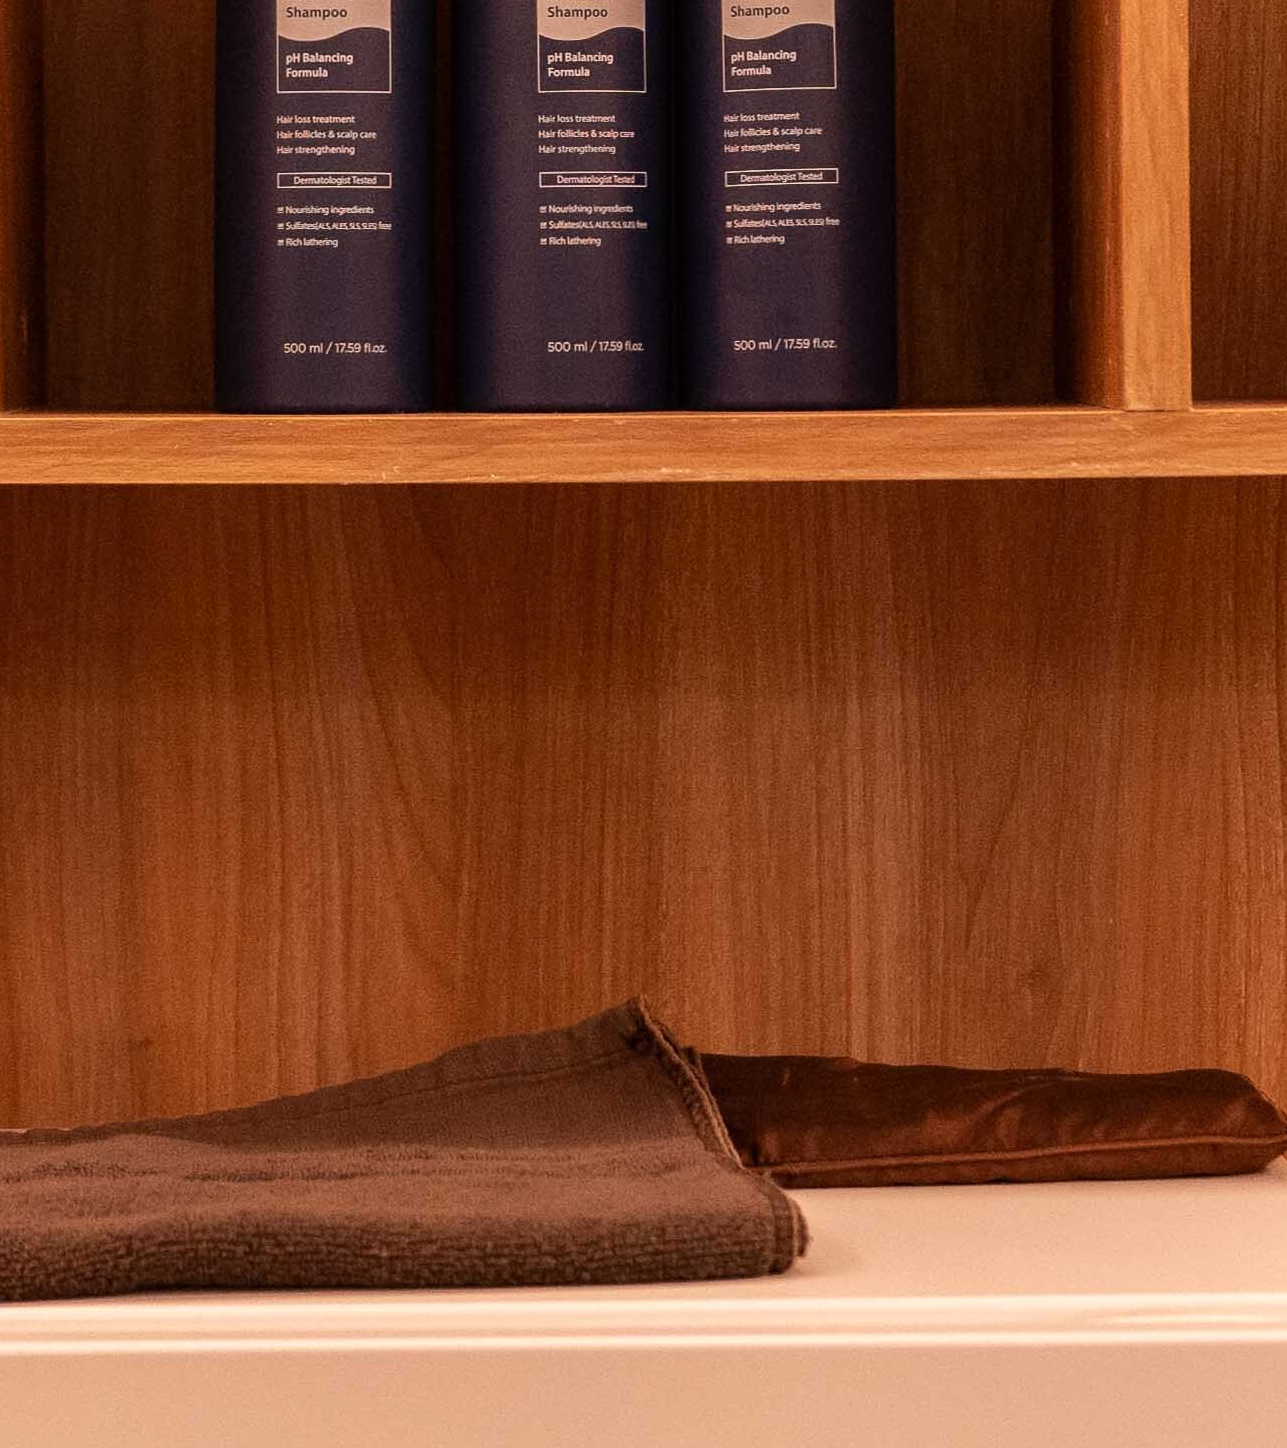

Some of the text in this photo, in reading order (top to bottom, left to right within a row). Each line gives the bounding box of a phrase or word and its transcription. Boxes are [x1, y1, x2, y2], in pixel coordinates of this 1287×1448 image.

[286, 6, 348, 21] Shampoo
[547, 5, 608, 21] Shampoo
[730, 5, 790, 19] Shampoo
[285, 52, 354, 66] pH Balancing
[547, 51, 614, 65] pH Balancing
[730, 49, 797, 64] pH Balancing
[285, 66, 329, 78] Formula
[547, 66, 591, 78] Formula
[731, 64, 772, 77] Formula
[276, 115, 355, 124] Hair loss treatment
[276, 130, 293, 139] Hair
[295, 130, 326, 139] follicles
[336, 130, 358, 140] scalp
[276, 145, 355, 156] Hair strengthening
[293, 176, 377, 186] Dermatologist Tested
[283, 342, 307, 353] 500
[309, 343, 323, 353] ml
[733, 339, 756, 351] 500
[758, 339, 772, 350] ml
